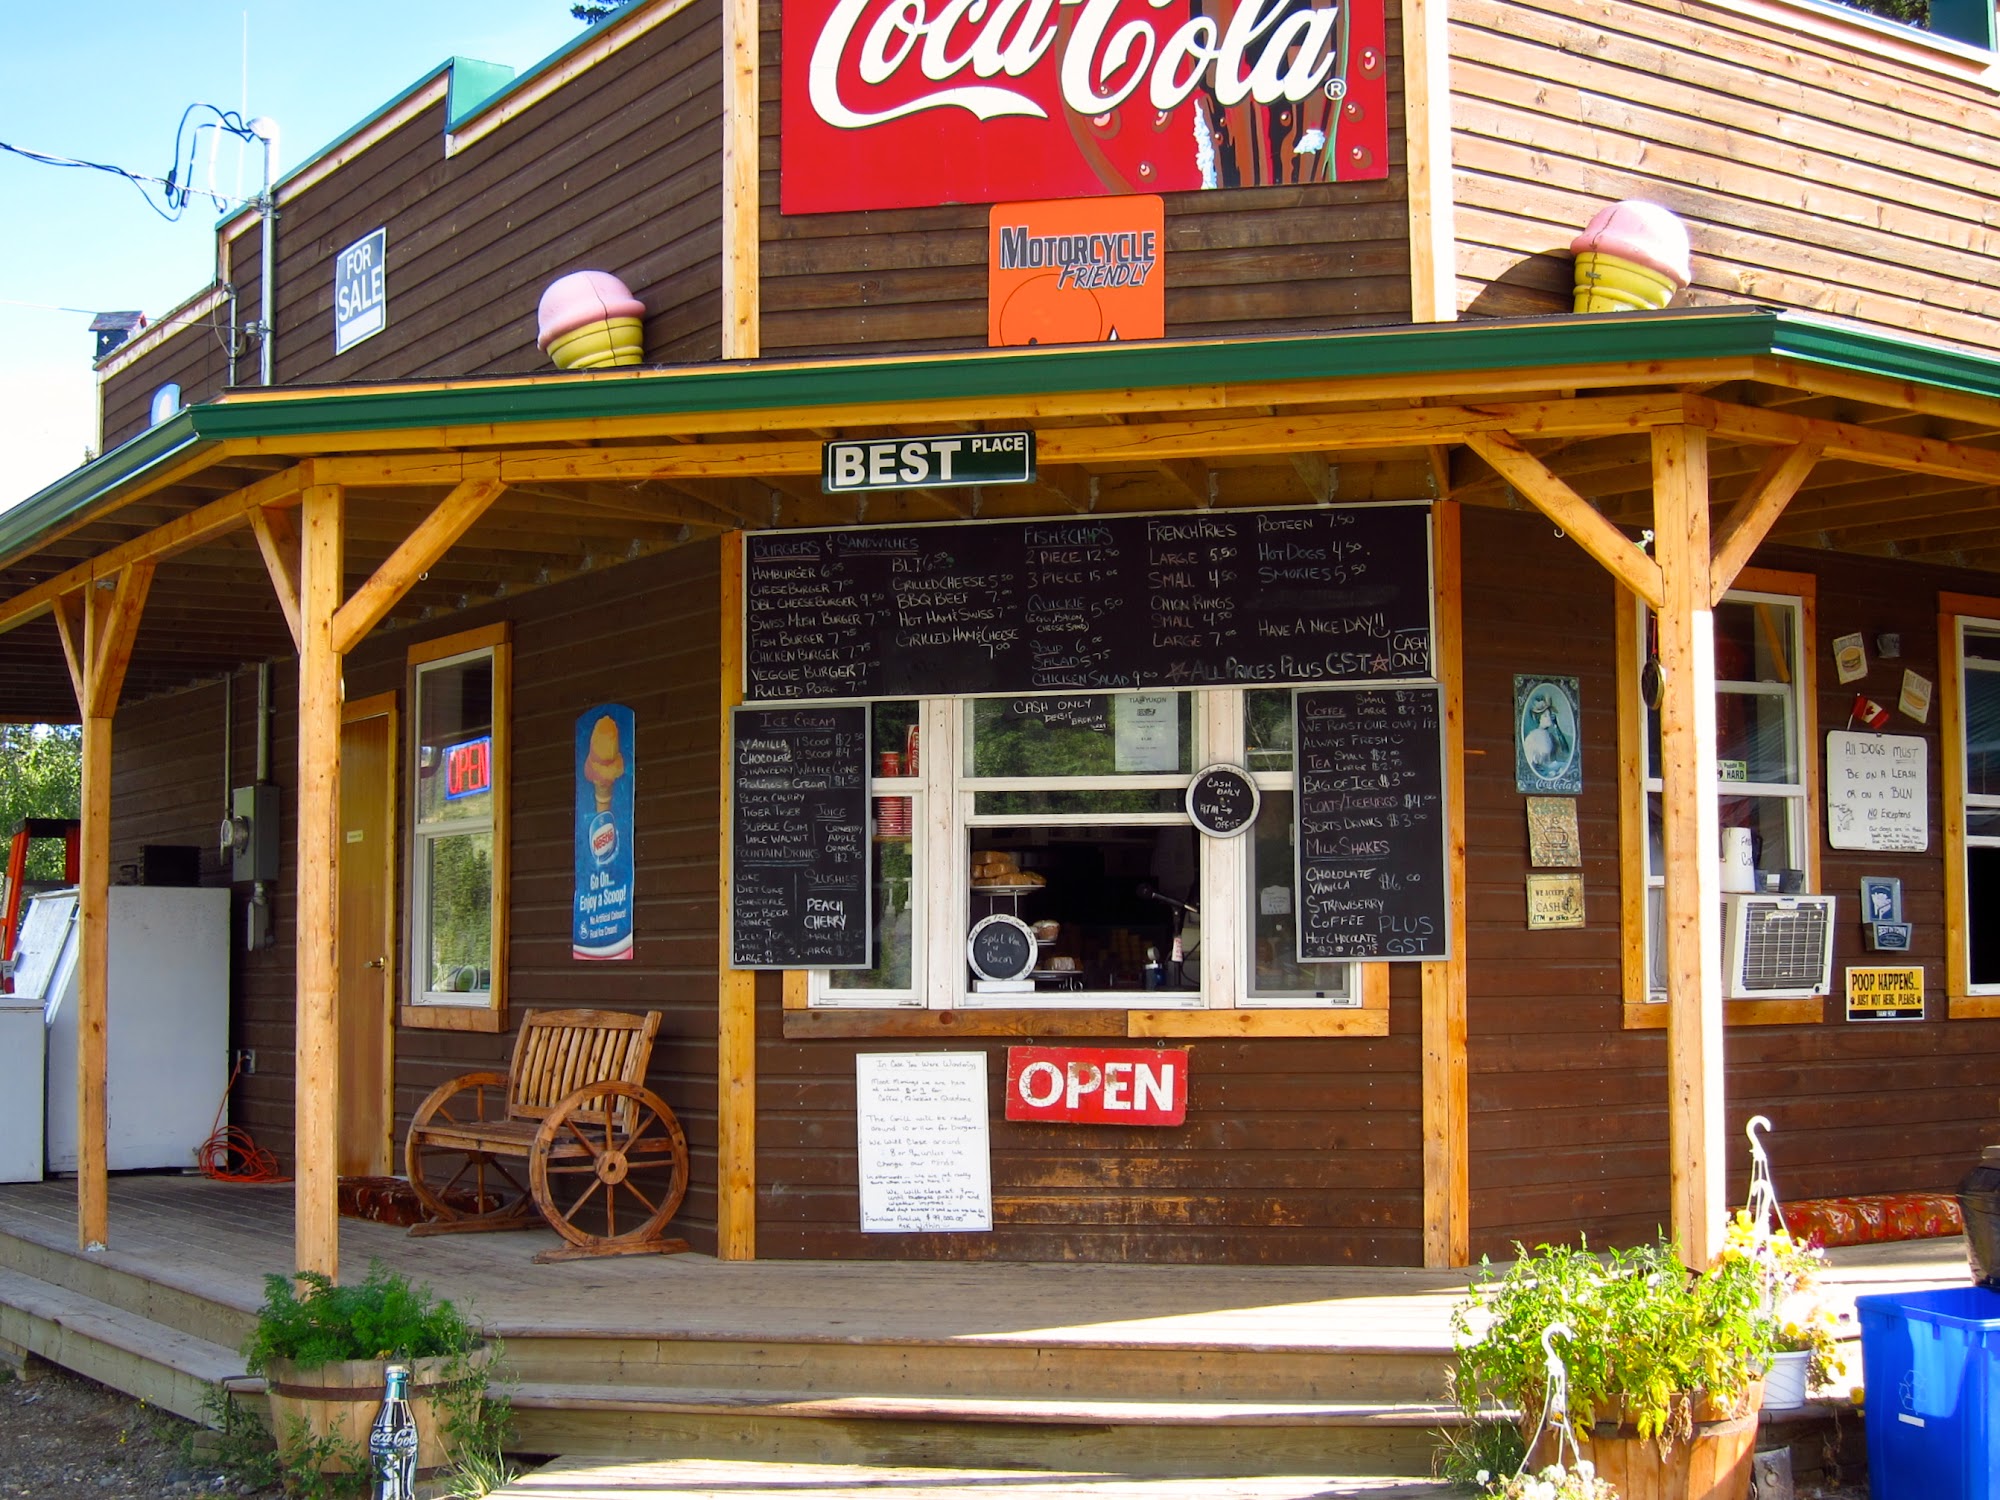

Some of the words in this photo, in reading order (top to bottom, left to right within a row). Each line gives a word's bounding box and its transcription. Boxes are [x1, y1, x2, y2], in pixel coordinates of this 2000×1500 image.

[999, 225, 1156, 270] MOTORCYCLE
[345, 243, 372, 280] FOR
[1057, 262, 1154, 291] FRIENDLY
[338, 264, 383, 323] SALE
[835, 440, 962, 487] BEST
[971, 437, 1024, 453] PLACE
[1147, 520, 1198, 542] FRENCH
[1198, 518, 1237, 538] FRIES
[1256, 515, 1313, 533] POOTEEN
[752, 539, 820, 558] BURGERS
[1150, 547, 1200, 566] LARGE
[1286, 542, 1327, 561] DOGS
[1040, 551, 1082, 565] PIECE
[752, 566, 816, 581] HAMBURGER
[1028, 572, 1039, 589] 3
[1042, 573, 1083, 585] PIECE
[1148, 571, 1196, 590] SMALL
[1258, 566, 1332, 584] SMOKIES
[940, 575, 988, 590] CHEESE
[751, 599, 775, 611] DBL
[896, 593, 932, 610] BBQ
[934, 592, 968, 606] BEEF
[1151, 595, 1190, 611] ONION
[1192, 594, 1235, 611] RINGS
[750, 614, 785, 632] SWISS
[821, 612, 864, 627] BURGER
[899, 610, 922, 628] HOT
[1258, 619, 1292, 637] HAVE
[1294, 618, 1306, 634] A
[1310, 619, 1341, 634] NICE
[752, 632, 776, 648] FISH
[779, 630, 824, 647] BURGER
[896, 631, 951, 648] GRILLED
[1153, 631, 1203, 648] LARGE
[1393, 633, 1428, 652] CASH
[750, 647, 795, 664] CHICKEN
[797, 648, 841, 662] BURGER
[1391, 651, 1429, 672] ONLY
[752, 667, 799, 682] VEGGIE
[803, 663, 857, 679] BURGER
[1225, 656, 1277, 681] PRICES
[1280, 655, 1325, 679] PLUS
[1088, 670, 1130, 687] SALAD
[806, 682, 837, 695] PORK
[1012, 700, 1049, 715] CASH
[1057, 698, 1093, 711] ONLY
[1305, 699, 1345, 717] COFFEE
[1357, 707, 1388, 716] LARGE
[760, 712, 788, 728] ICE
[794, 712, 836, 728] CREAM
[1043, 711, 1072, 724] DEBIT
[1301, 721, 1322, 733] WE
[1363, 720, 1388, 731] OUR
[1302, 737, 1346, 751] ALWAYS
[1350, 734, 1390, 747] FRESH
[1859, 742, 1886, 756] DOGS
[1892, 745, 1919, 759] MUST
[449, 741, 490, 795] OPEN
[832, 762, 860, 775] CONE
[1307, 754, 1332, 770] TEA
[1726, 769, 1745, 780] HARD
[1866, 771, 1877, 779] ON
[1881, 770, 1887, 778] A
[1892, 768, 1917, 779] LEASH
[792, 777, 828, 789] Cream
[1206, 777, 1233, 789] CASH
[1302, 775, 1332, 795] BAG
[1333, 778, 1350, 789] OF
[1350, 775, 1377, 790] ICE
[1216, 788, 1241, 797] ONLY
[1846, 789, 1857, 799] OR
[1861, 791, 1872, 799] ON
[1879, 790, 1884, 799] A
[1890, 786, 1912, 799] BUN
[740, 806, 771, 818] TIGER
[815, 803, 847, 817] JUICE
[1200, 803, 1219, 815] ATM
[1867, 808, 1878, 818] NO
[782, 820, 810, 833] GUM
[1301, 816, 1342, 835] SPORTS
[1343, 812, 1384, 831] DRINKS
[827, 832, 858, 844] APPLE
[1305, 838, 1339, 859] MILK
[1338, 836, 1392, 856] SHAKES
[590, 873, 600, 892] Go
[1304, 867, 1378, 882] CHOCOLATE
[1308, 881, 1351, 895] VANILLA
[579, 895, 597, 914] Enjoy
[598, 892, 603, 908] a
[604, 883, 627, 907] Scoop!
[806, 897, 844, 917] PEACH
[1306, 895, 1385, 915] STRAWBERRY
[1536, 902, 1560, 914] CASH
[803, 914, 847, 930] CHERRY
[1310, 914, 1367, 929] COFFEE
[1377, 914, 1435, 935] PLUS
[1304, 931, 1325, 944] HOT
[1385, 937, 1429, 954] GST
[733, 952, 762, 963] LARGE
[986, 951, 1014, 965] Bacon
[1851, 973, 1875, 991] POOP
[1856, 994, 1868, 1006] JUST
[1871, 994, 1881, 1006] NOT
[1898, 993, 1916, 1006] PLEASE
[1018, 1060, 1175, 1112] OPEN
